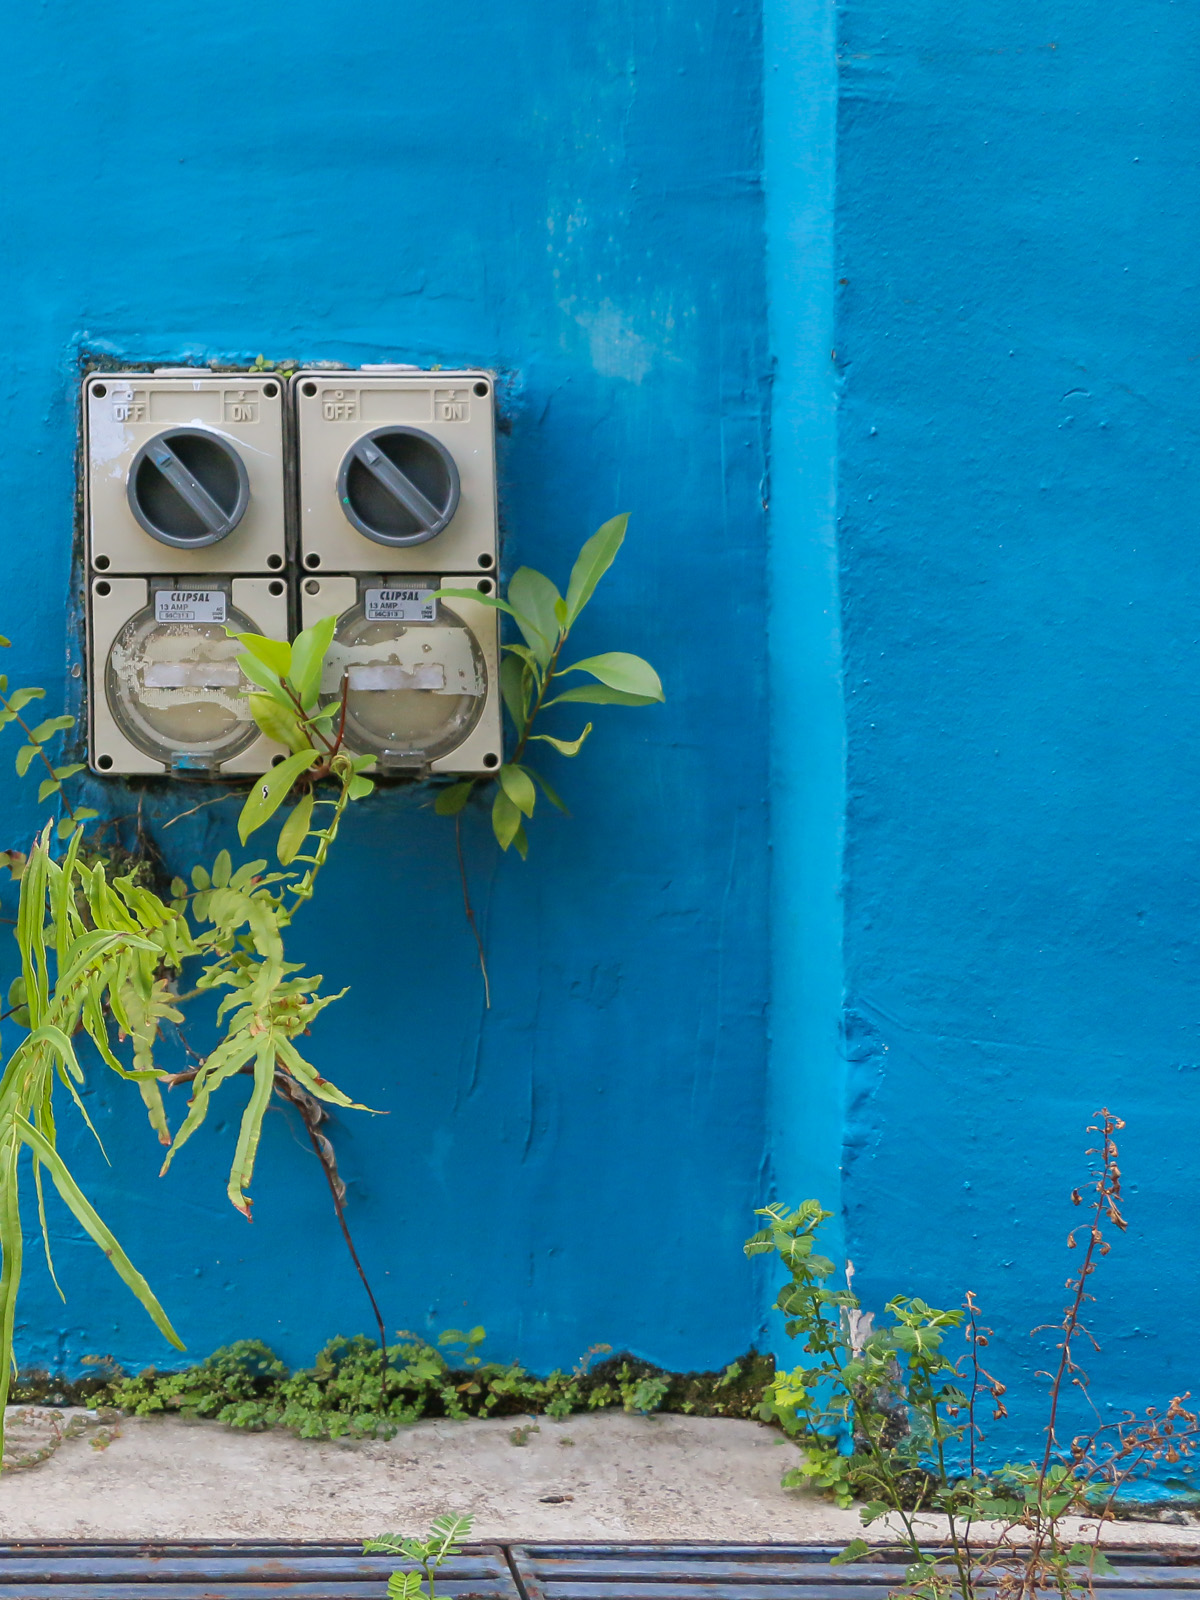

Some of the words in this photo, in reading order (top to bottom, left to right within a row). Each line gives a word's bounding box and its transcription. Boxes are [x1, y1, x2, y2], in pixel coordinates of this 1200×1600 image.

[114, 404, 146, 421] OFF
[232, 404, 253, 422] ON
[324, 403, 355, 420] OFF
[442, 403, 463, 421] ON
[171, 592, 210, 602] CLIPSAL
[380, 591, 419, 601] CLIPSAL
